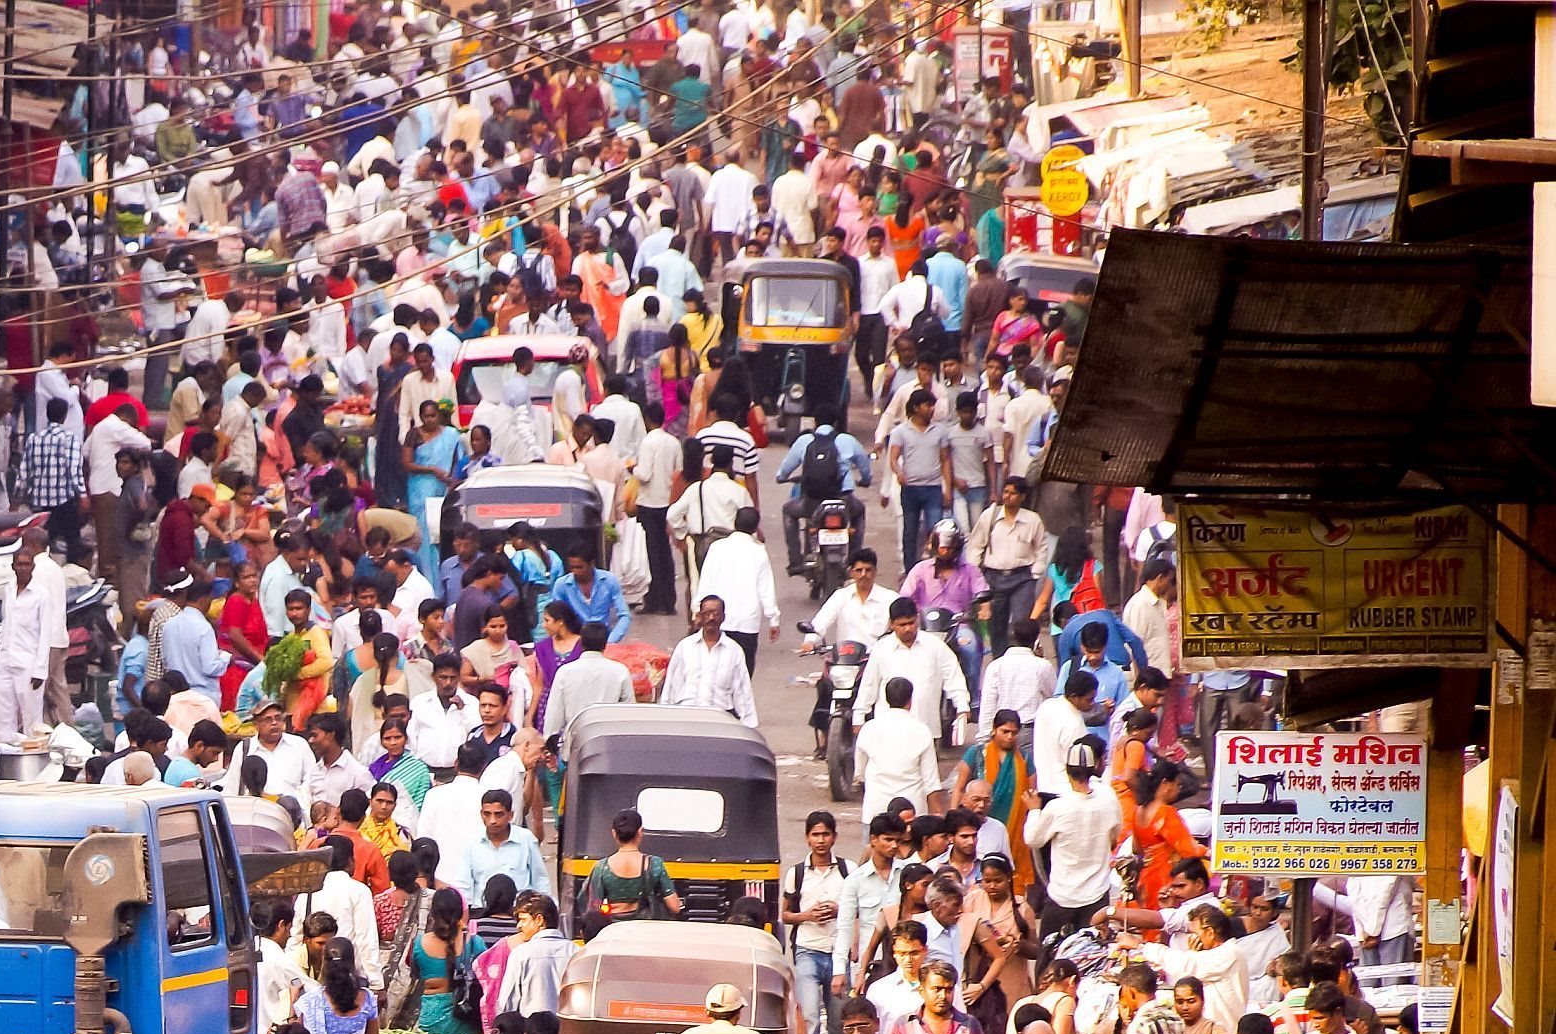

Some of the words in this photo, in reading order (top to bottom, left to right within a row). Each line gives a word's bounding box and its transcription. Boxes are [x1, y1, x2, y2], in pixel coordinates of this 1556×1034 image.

[1188, 516, 1246, 544] किरण
[1413, 515, 1469, 538] KIRAN
[1362, 557, 1464, 599] URGENT
[1189, 612, 1243, 634] रबर
[1349, 607, 1416, 629] RUBBER
[1421, 606, 1477, 629] STAMP
[1227, 735, 1325, 768] शिलाई
[1332, 735, 1423, 766] मशिन
[1389, 770, 1421, 792] सर्विस
[1223, 821, 1246, 838] जुनी
[1249, 817, 1281, 835] शिलाई
[1284, 818, 1313, 834] मशिन
[1316, 817, 1345, 835] विकत
[1385, 818, 1419, 835] जातील
[1252, 858, 1281, 869] 9322
[1284, 858, 1306, 869] 966
[1309, 858, 1330, 869] 026
[1340, 858, 1368, 870] 9967
[1372, 858, 1393, 869] 358
[1396, 858, 1418, 870] 279
